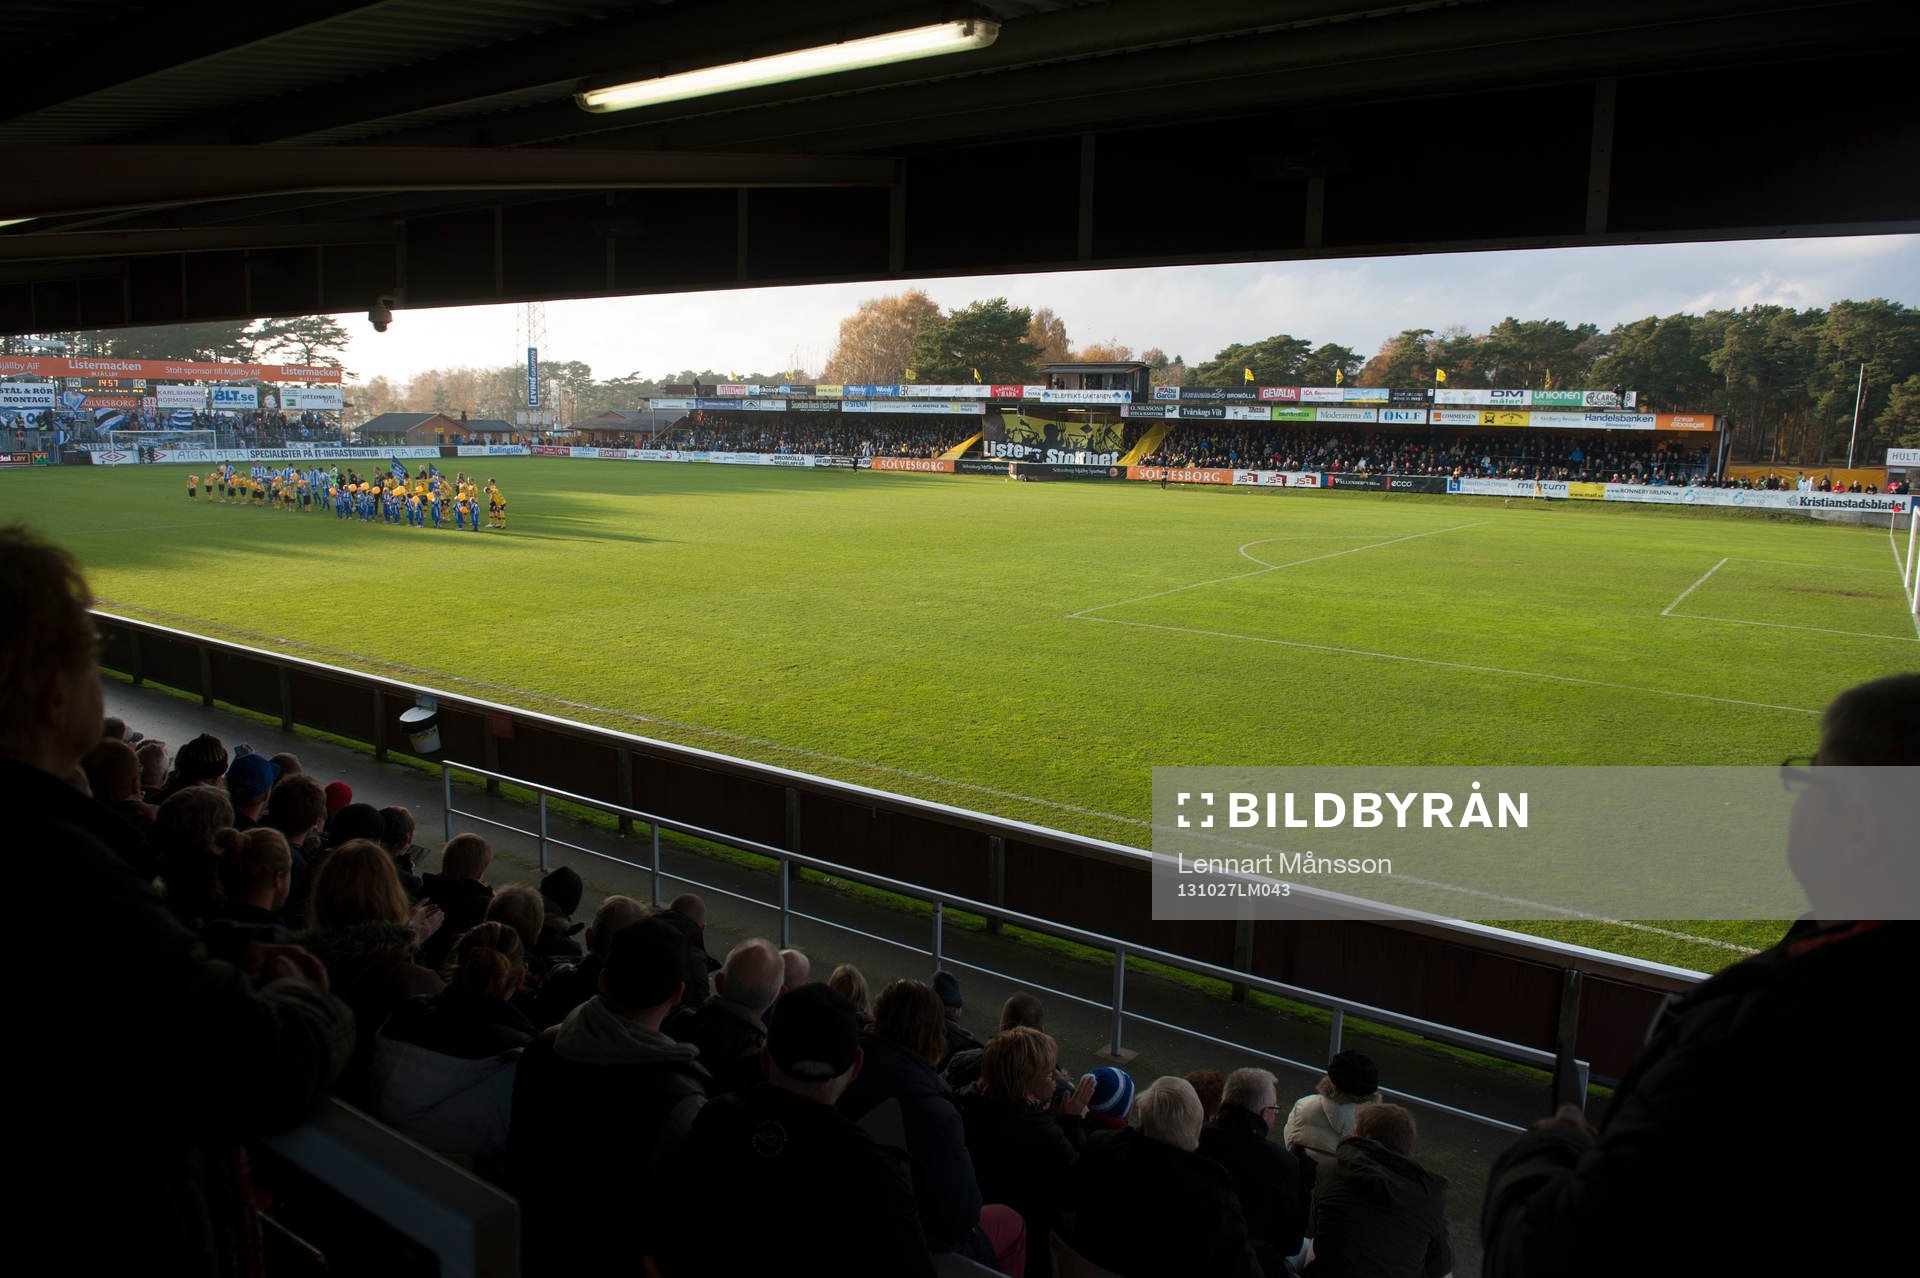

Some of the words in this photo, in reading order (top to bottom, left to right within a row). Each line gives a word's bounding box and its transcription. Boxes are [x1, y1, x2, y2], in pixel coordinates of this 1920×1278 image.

[68, 360, 142, 371] Listermacken
[184, 368, 212, 377] sponsor
[224, 368, 250, 377] Mjällby
[281, 367, 340, 377] Listermacken
[36, 387, 53, 395] RÖR
[1262, 388, 1296, 399] GEVALIA
[1490, 390, 1524, 398] DM
[1535, 391, 1581, 400] unionen
[3, 396, 51, 404] MONTAGE
[215, 390, 255, 402] BLT.se
[1584, 414, 1654, 423] Handelsbanken
[250, 450, 301, 458] SPECIALISTER
[303, 449, 313, 458] PÅ
[315, 449, 380, 458] IT-INFRASTRUKTUR
[1391, 480, 1413, 488] ecco
[1800, 496, 1907, 510] Kristianstadsbladet
